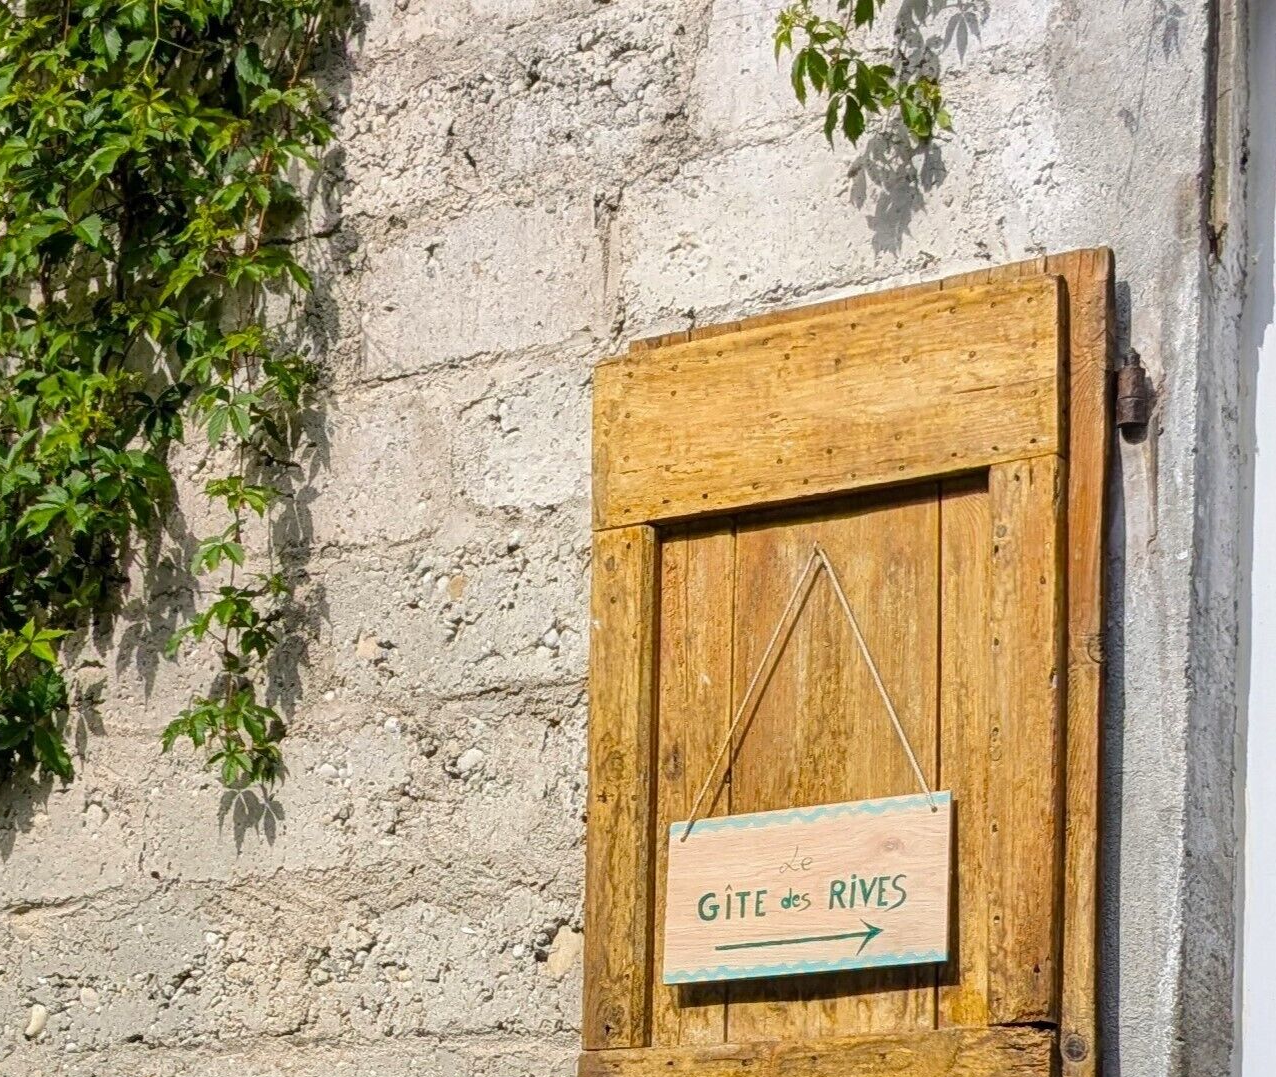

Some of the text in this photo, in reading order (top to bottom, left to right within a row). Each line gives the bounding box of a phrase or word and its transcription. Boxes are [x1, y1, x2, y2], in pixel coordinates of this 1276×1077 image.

[779, 845, 813, 874] Le
[697, 884, 768, 921] GÎTE
[780, 888, 812, 912] des
